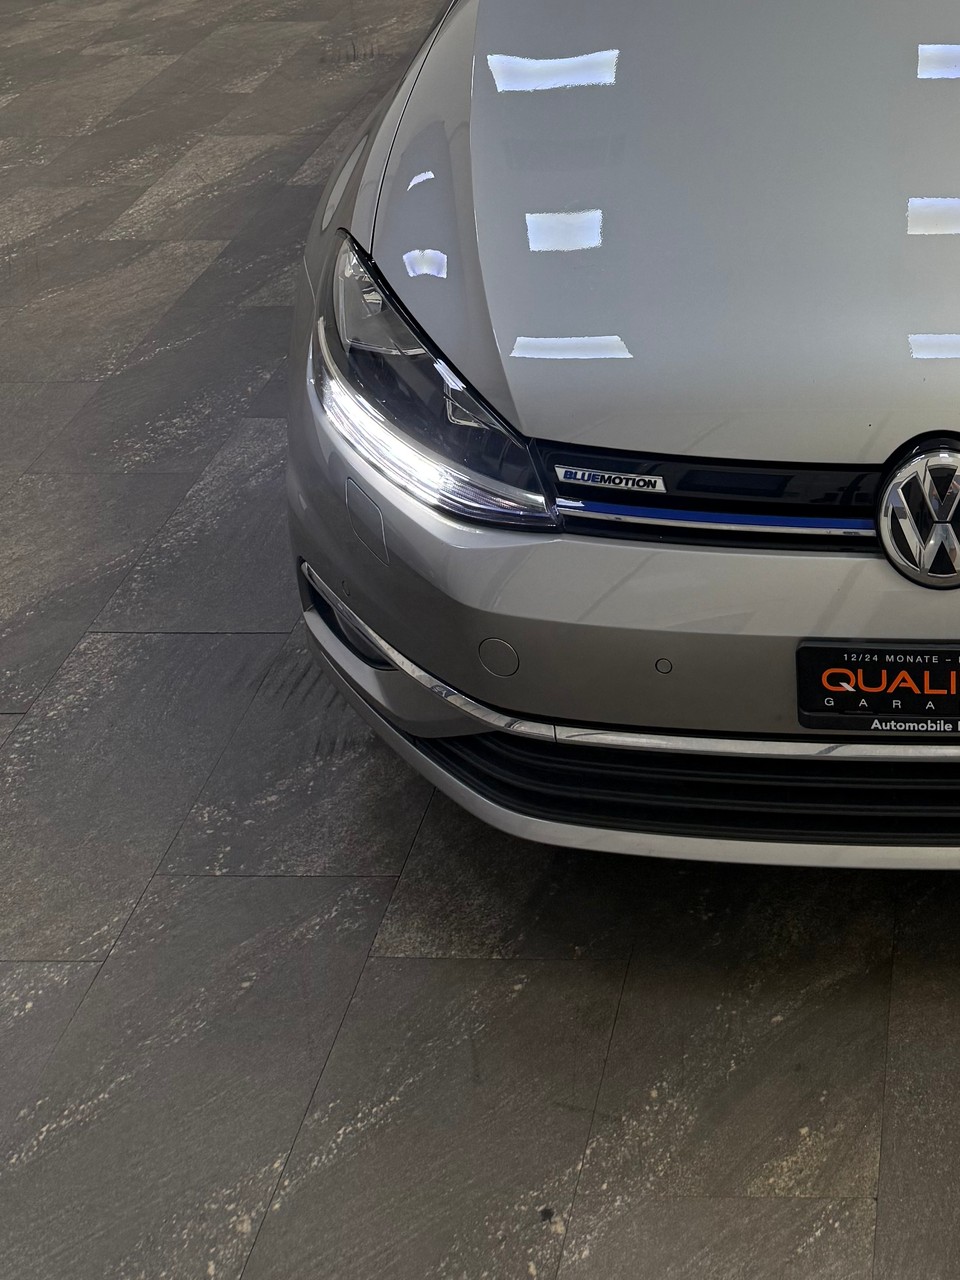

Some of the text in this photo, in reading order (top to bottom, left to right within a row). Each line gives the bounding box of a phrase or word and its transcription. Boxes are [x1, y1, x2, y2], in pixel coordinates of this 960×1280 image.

[563, 469, 657, 489] BLUEMOTION
[843, 653, 878, 662] 12/24
[885, 654, 939, 663] MONATE
[870, 719, 953, 732] Automobile
